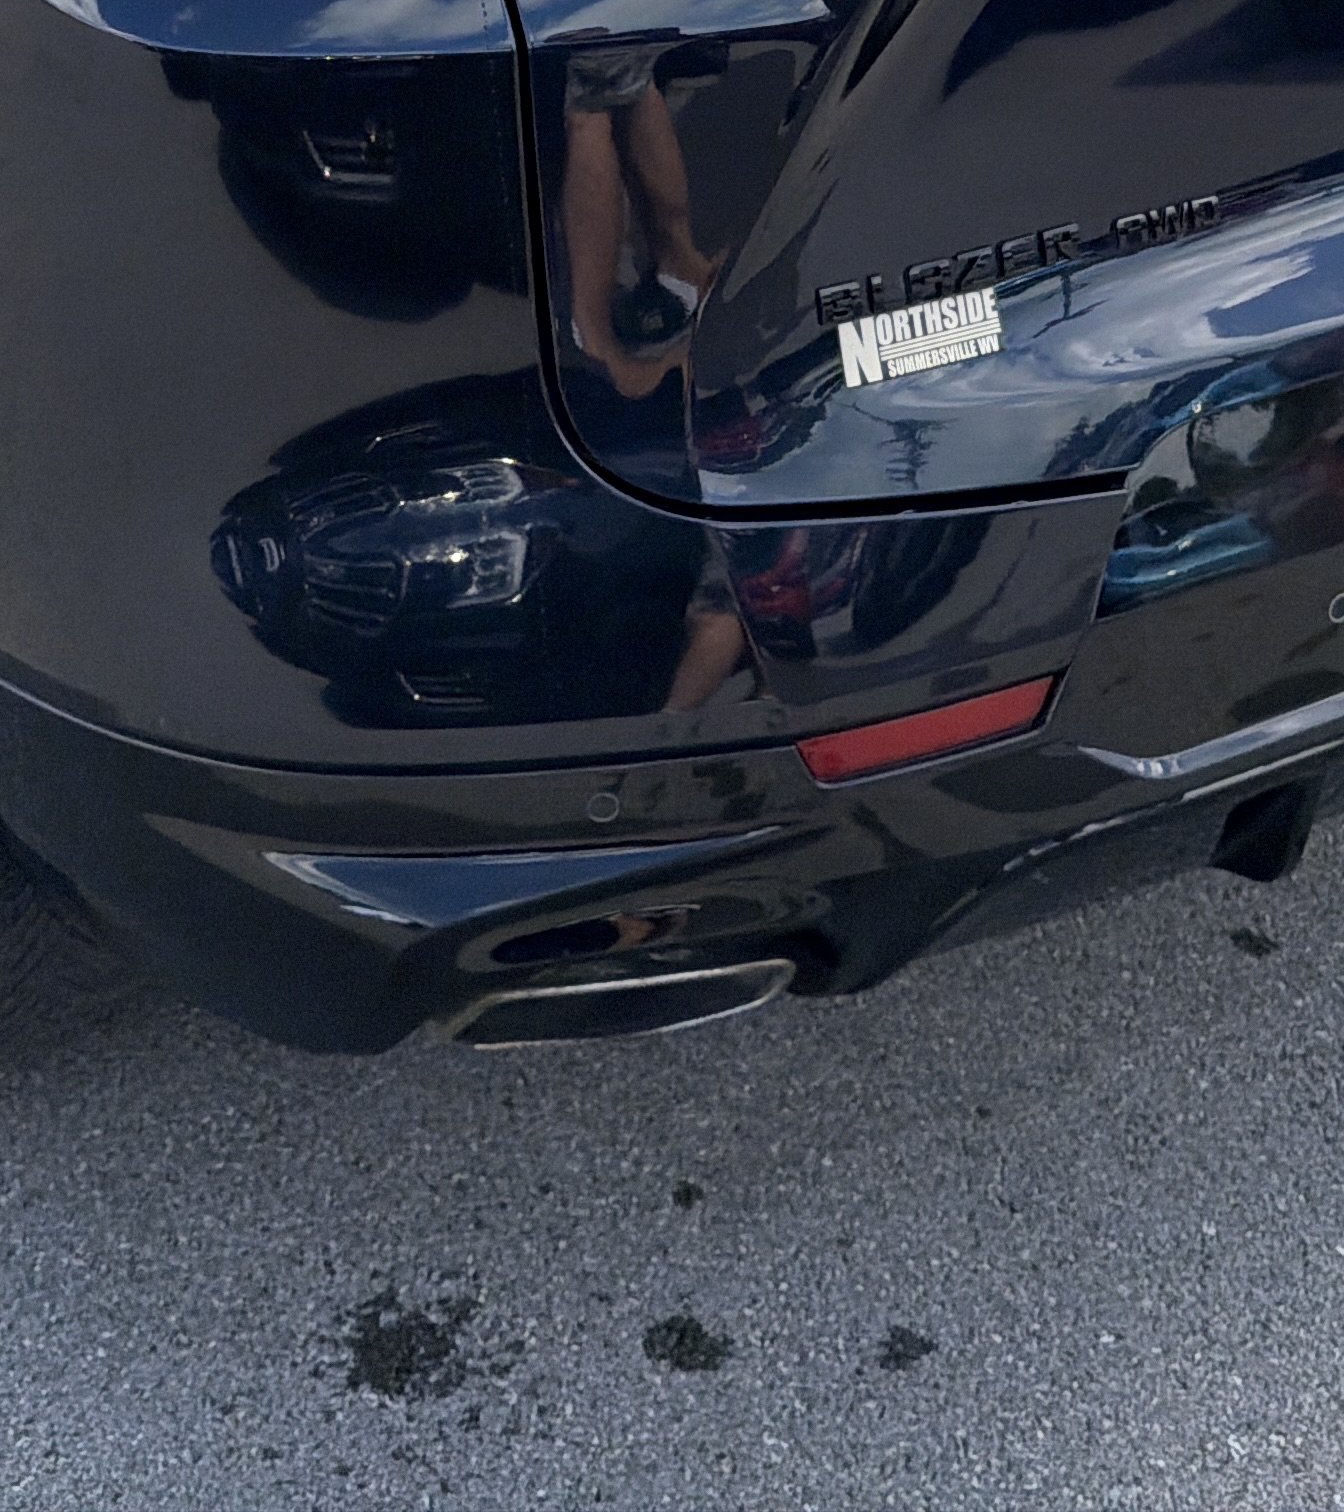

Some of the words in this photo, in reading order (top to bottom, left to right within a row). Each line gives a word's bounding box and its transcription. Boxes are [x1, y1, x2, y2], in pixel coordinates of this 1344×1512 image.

[817, 222, 1080, 324] BLAZER
[1111, 194, 1220, 248] AWD
[837, 286, 999, 388] NORTHSIDE
[887, 339, 978, 378] SUMMERSVILLE
[976, 333, 1000, 356] WV
